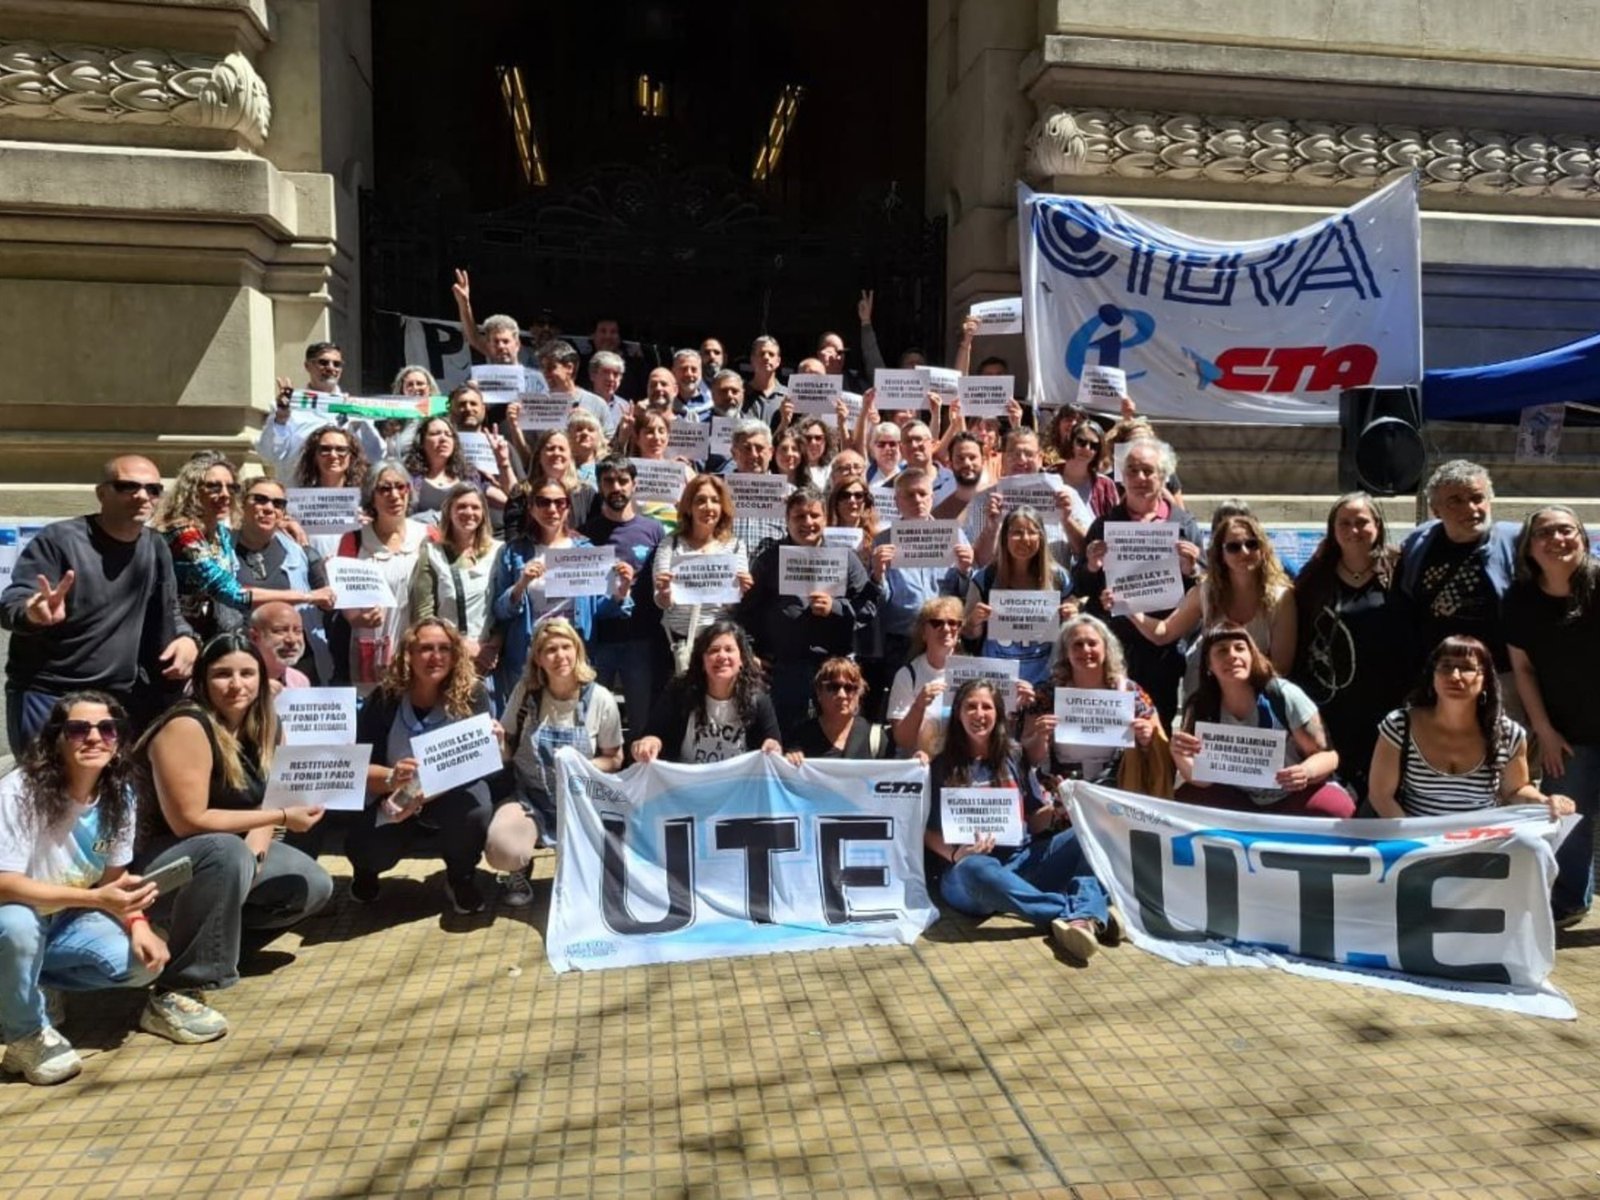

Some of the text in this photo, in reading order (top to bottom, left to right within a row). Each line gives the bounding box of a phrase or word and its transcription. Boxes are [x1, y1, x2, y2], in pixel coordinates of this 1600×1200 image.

[1213, 344, 1378, 392] CTA
[555, 554, 604, 563] URGENTE
[1000, 598, 1047, 606] URGENTE
[289, 701, 341, 712] RESTITUCIÓN
[1066, 698, 1122, 707] URGENTE
[456, 731, 474, 743] LEY
[424, 736, 490, 766] FINANCIAMIENTO
[290, 758, 350, 770] RESTITUCIÓN
[874, 782, 923, 794] CTA
[601, 811, 899, 935] UTE
[1129, 829, 1511, 985] UTE
